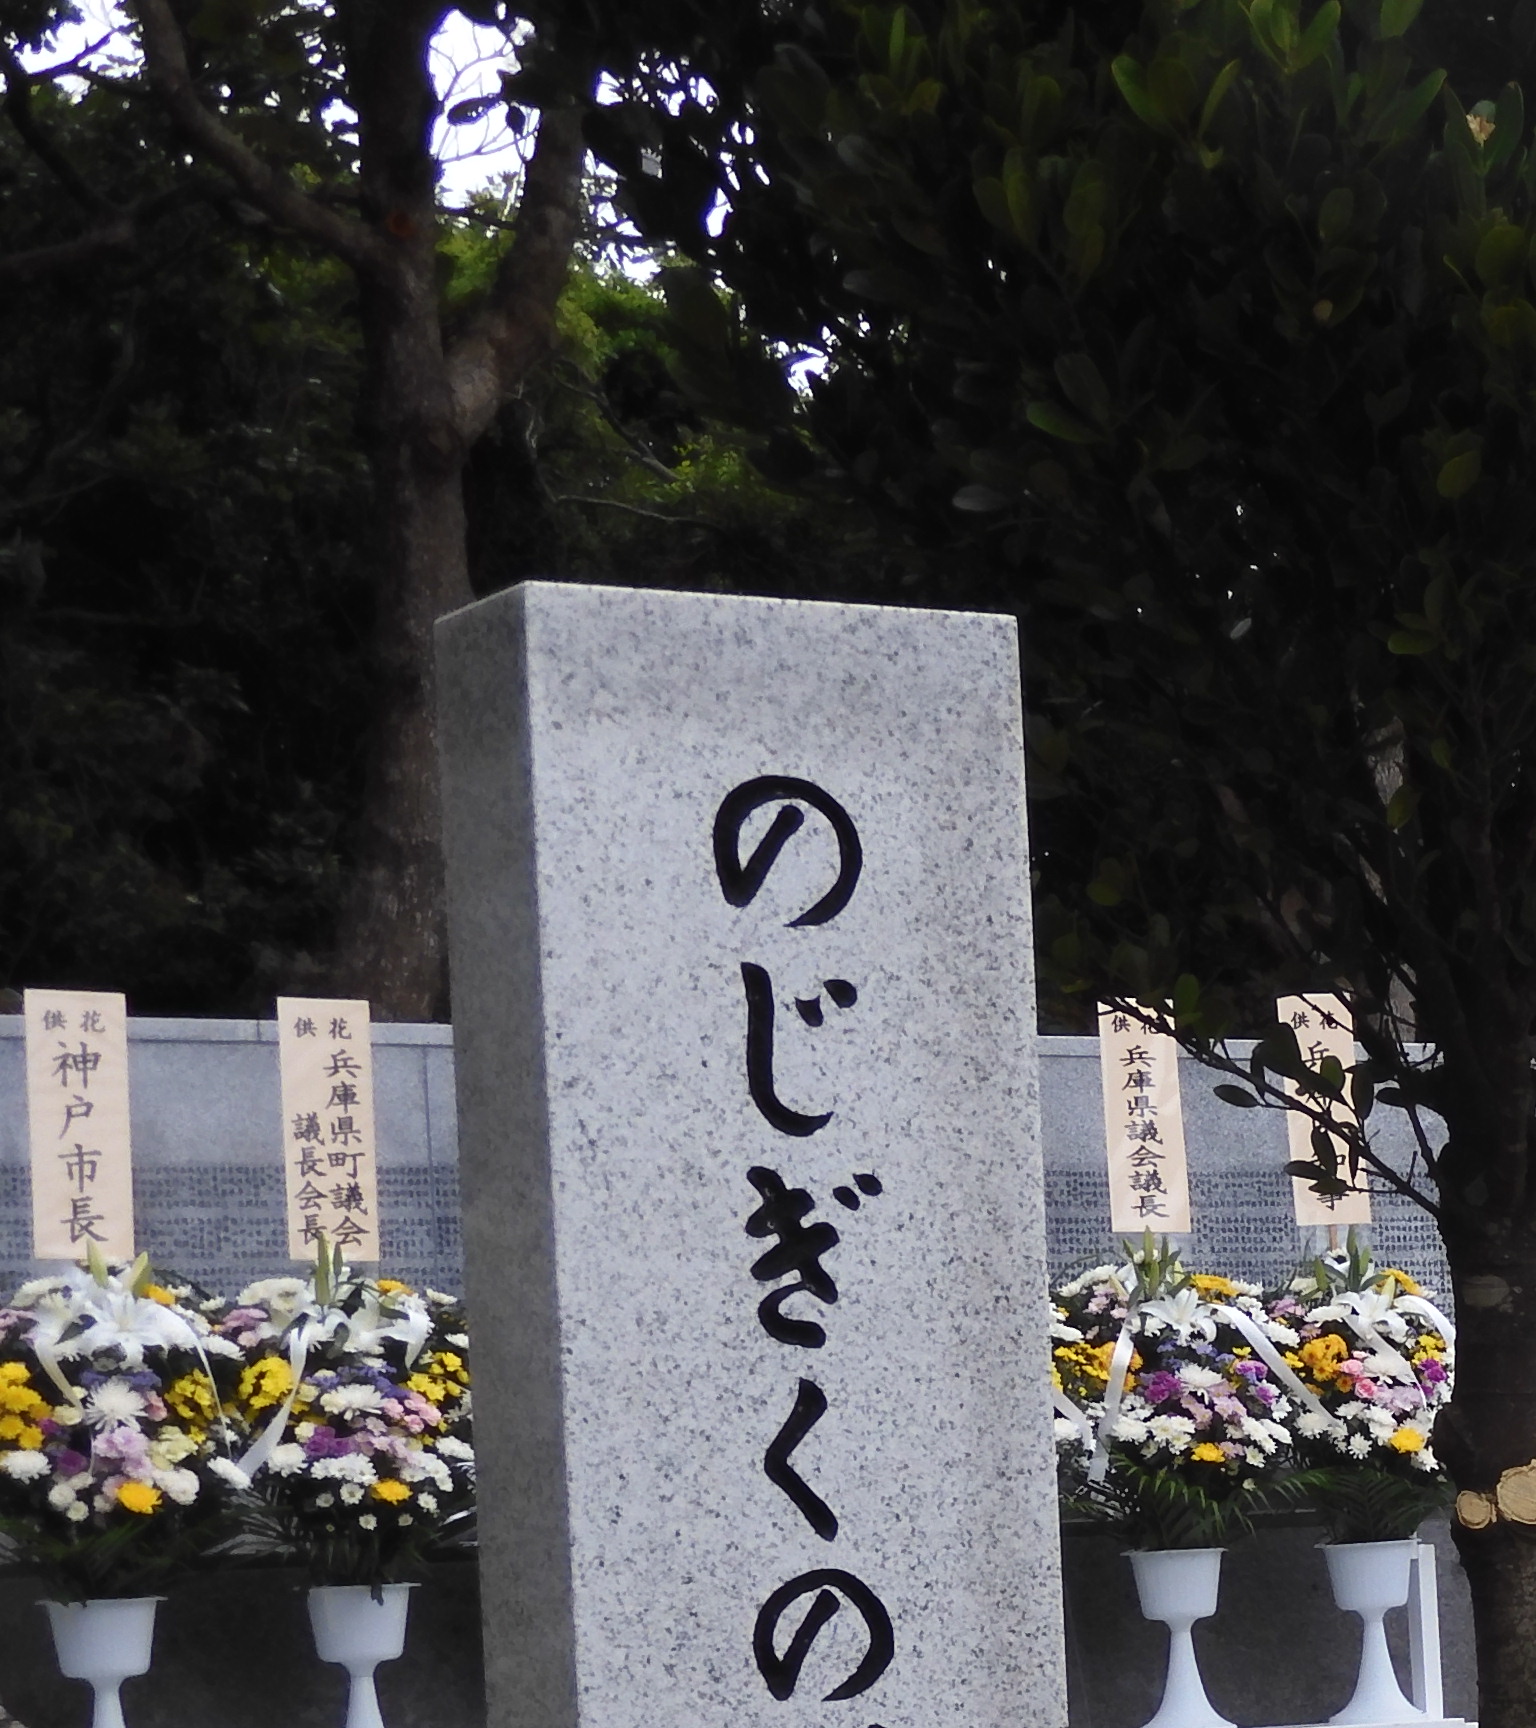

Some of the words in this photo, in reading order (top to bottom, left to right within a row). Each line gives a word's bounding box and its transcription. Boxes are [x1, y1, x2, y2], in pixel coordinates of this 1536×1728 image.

[42, 1009, 105, 1034] 供花
[294, 1017, 353, 1040] 供花
[51, 1041, 108, 1243] 神戸市長
[291, 1112, 328, 1245] 議長会長
[323, 1048, 370, 1247] 兵庫県町議会
[1120, 1044, 1169, 1219] 兵庫県議会議長
